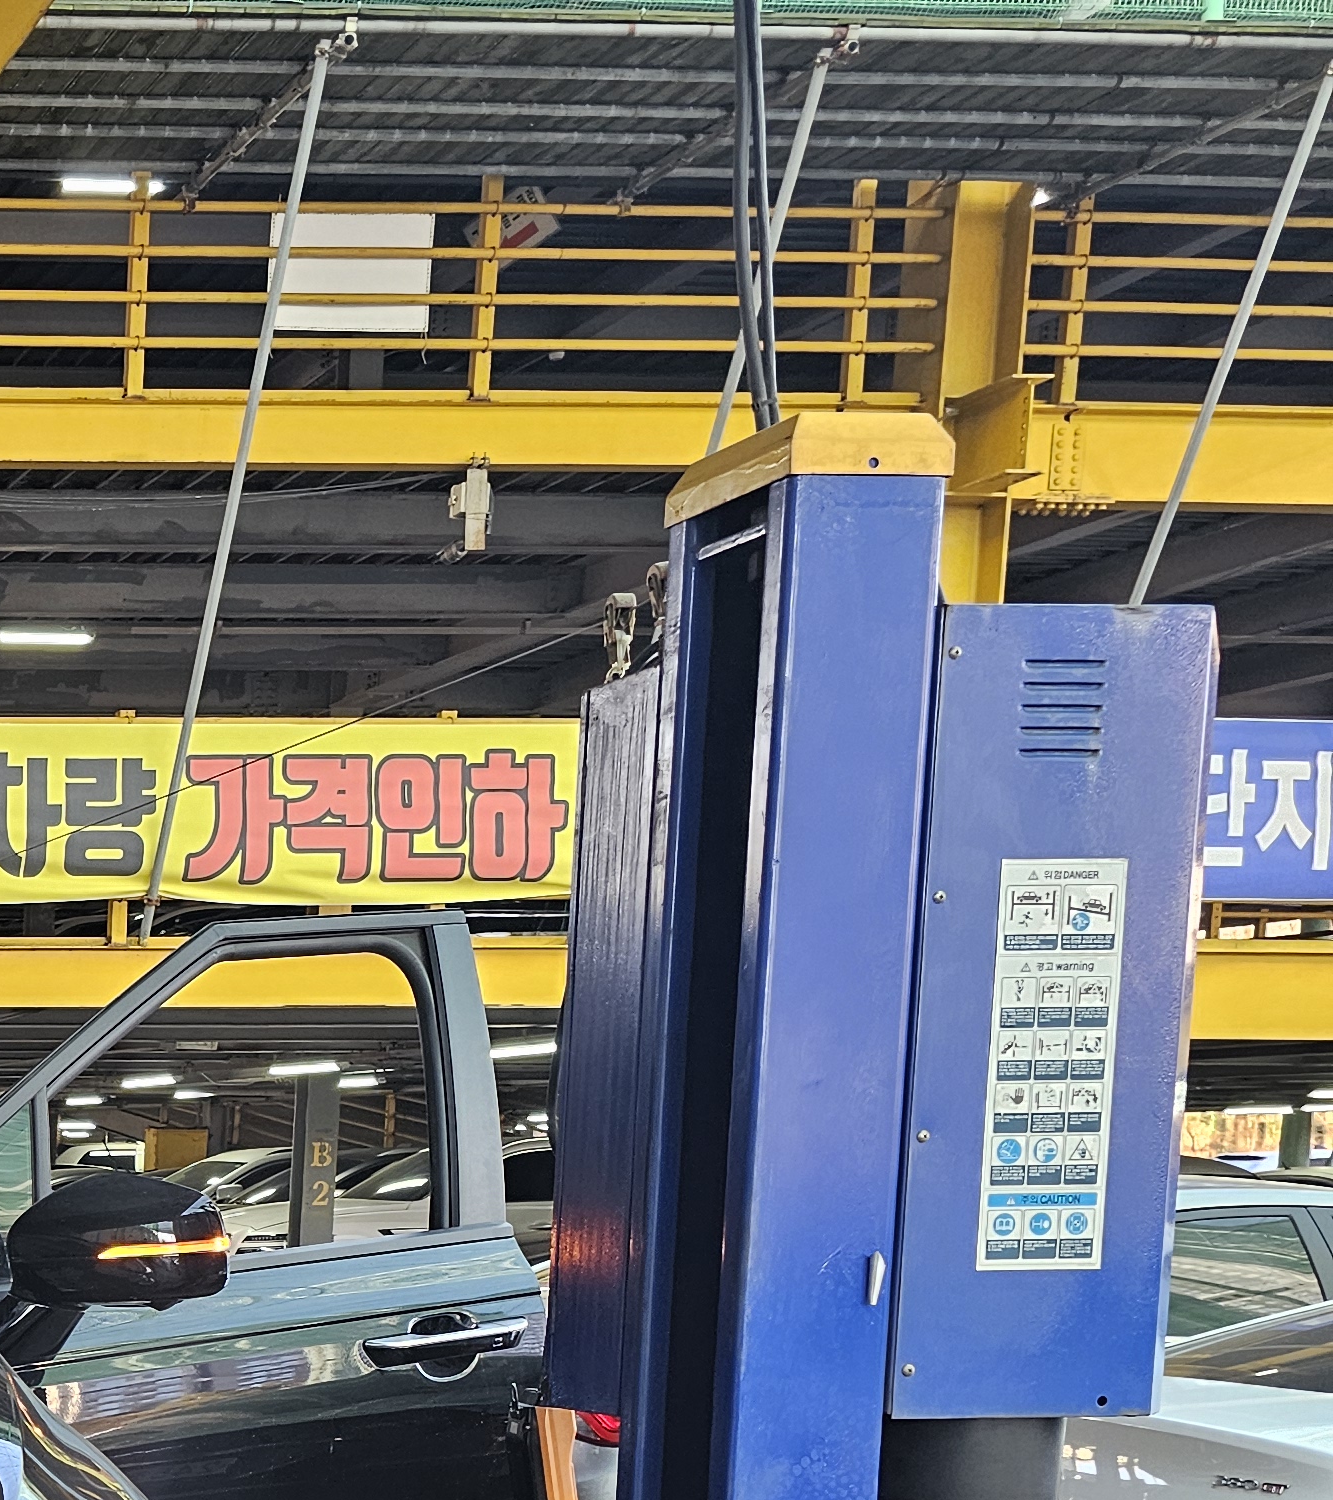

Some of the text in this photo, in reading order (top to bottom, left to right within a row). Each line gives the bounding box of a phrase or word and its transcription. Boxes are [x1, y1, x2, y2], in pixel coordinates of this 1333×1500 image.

[185, 748, 567, 884] 가격인하
[310, 1141, 332, 1167] B
[312, 1180, 329, 1206] 2
